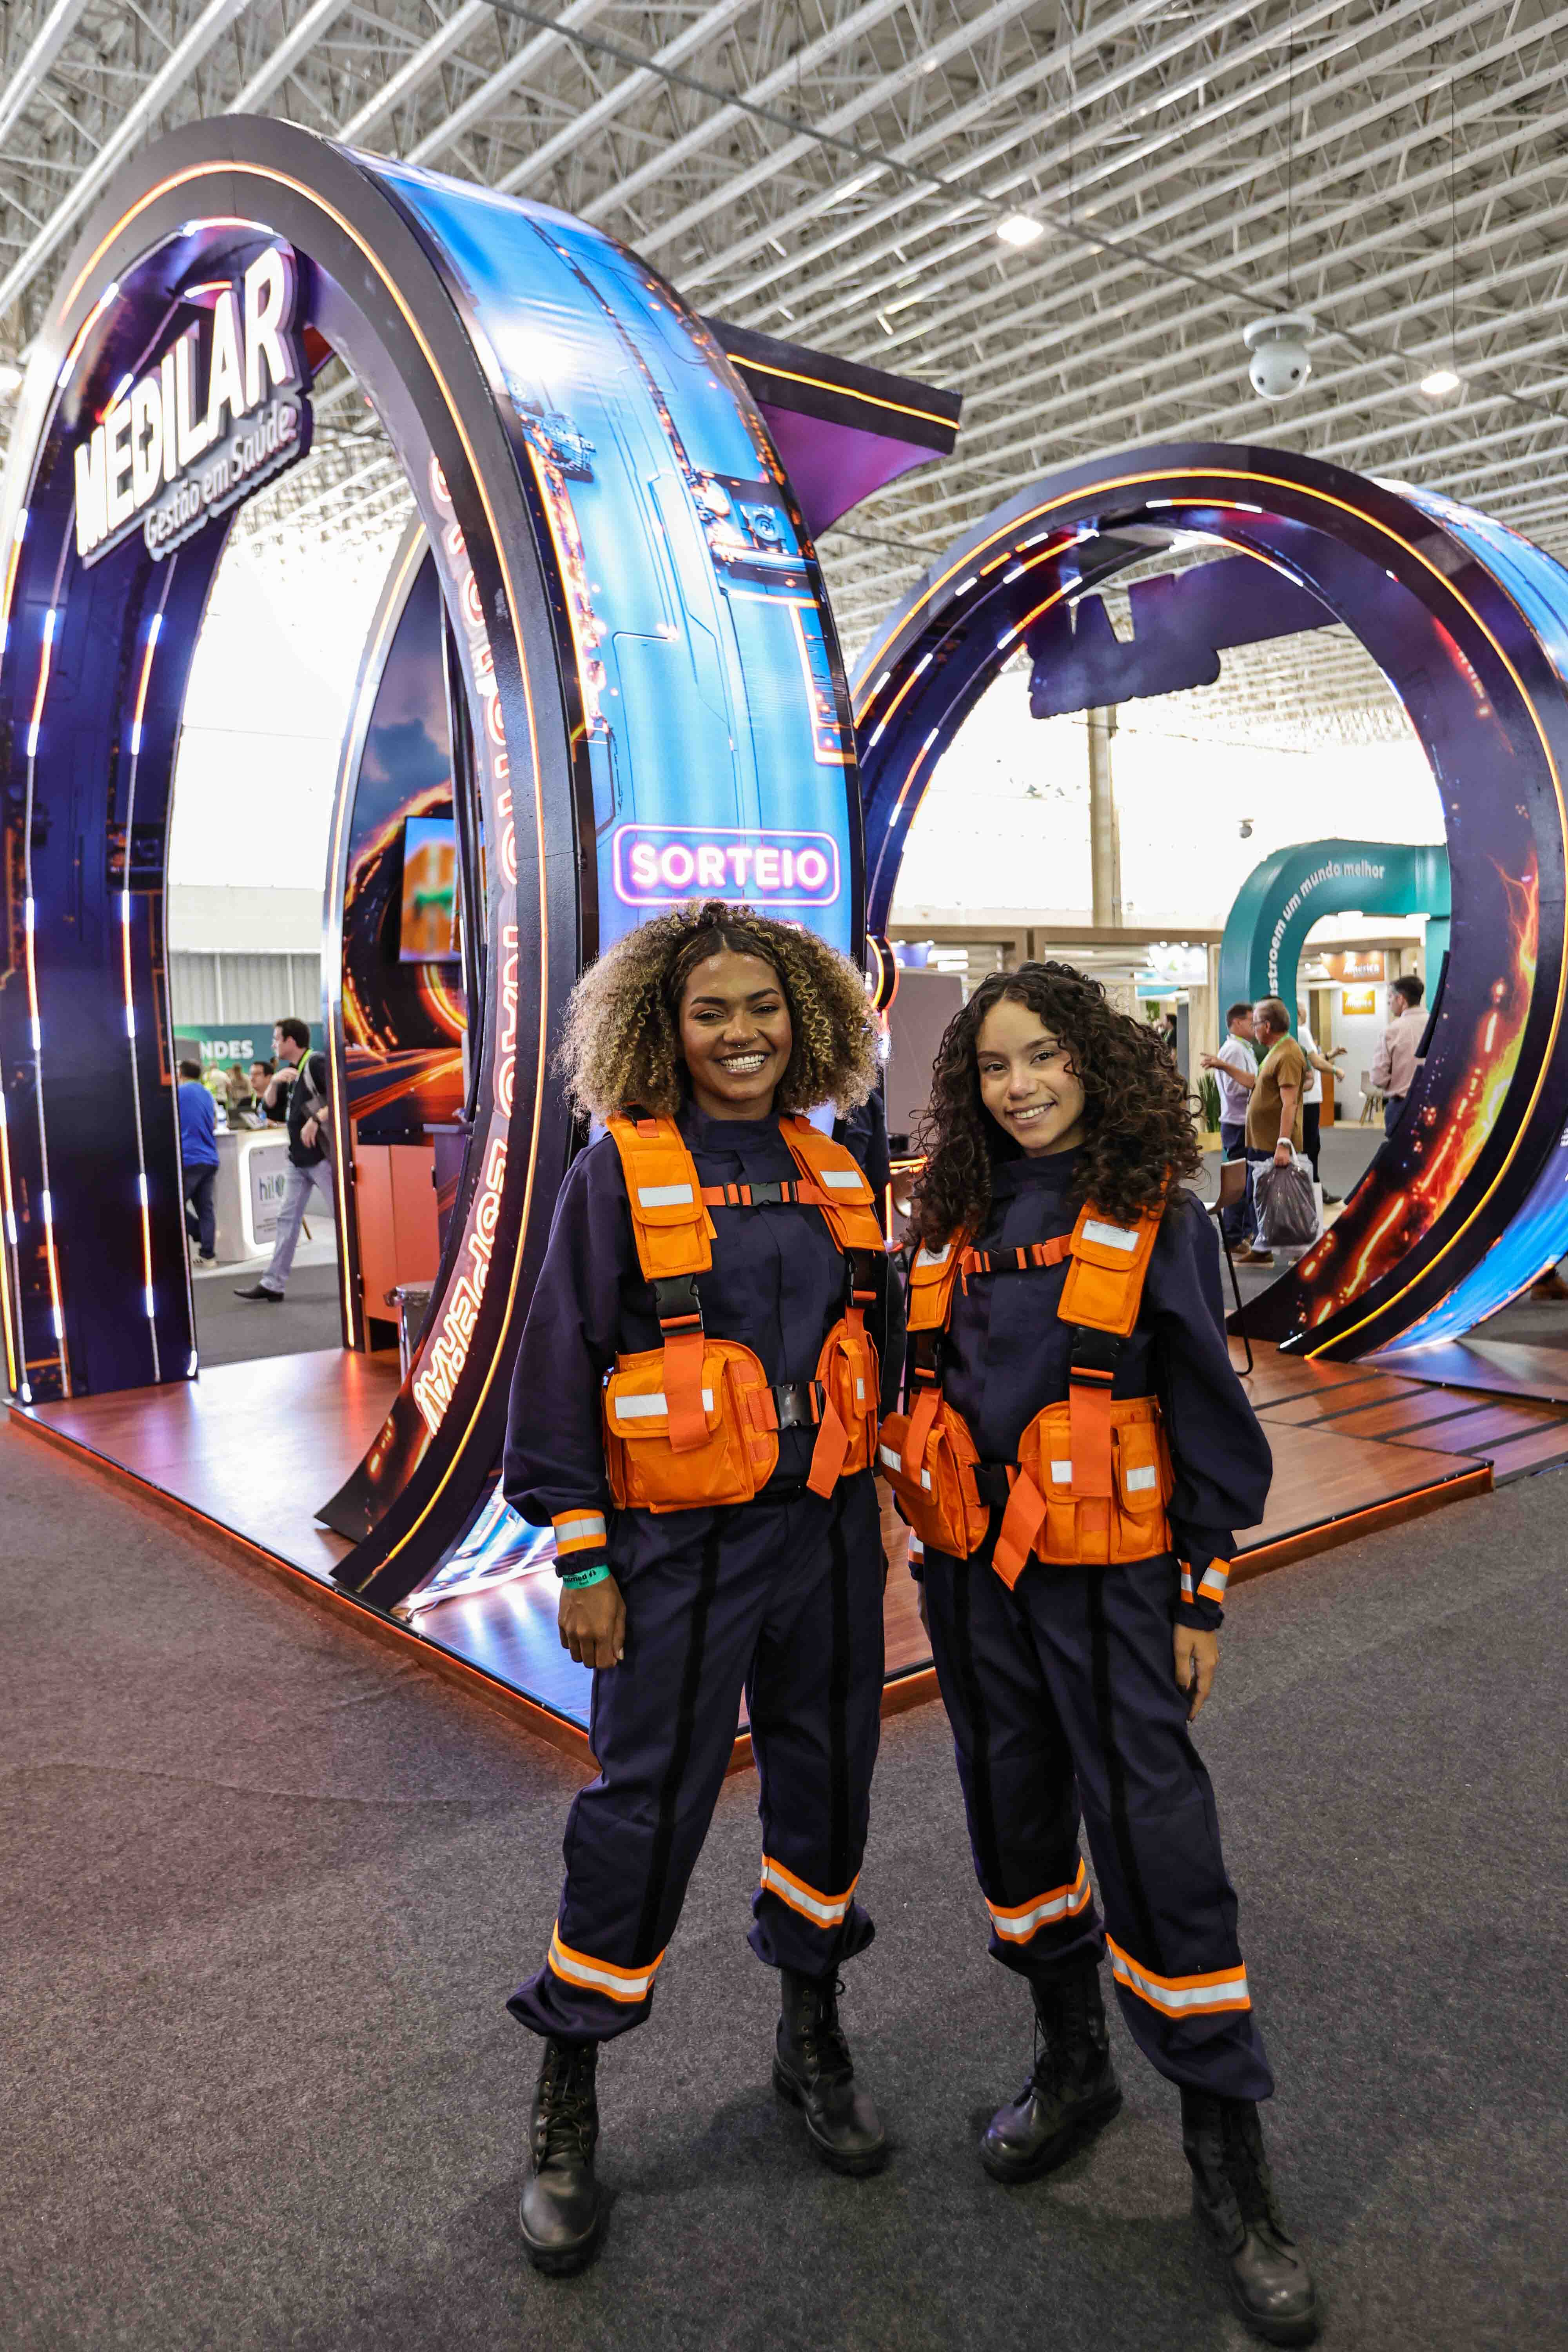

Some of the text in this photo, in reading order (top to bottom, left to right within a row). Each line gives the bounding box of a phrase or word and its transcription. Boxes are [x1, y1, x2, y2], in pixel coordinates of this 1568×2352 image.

[74, 247, 289, 556] MEDILAR
[144, 399, 294, 548] Gestão em Saúde
[632, 844, 827, 888] SORTEIO
[1282, 893, 1301, 922] um
[1299, 860, 1341, 897] mundo
[1343, 859, 1386, 879] melhor
[563, 1573, 588, 1583] nimed
